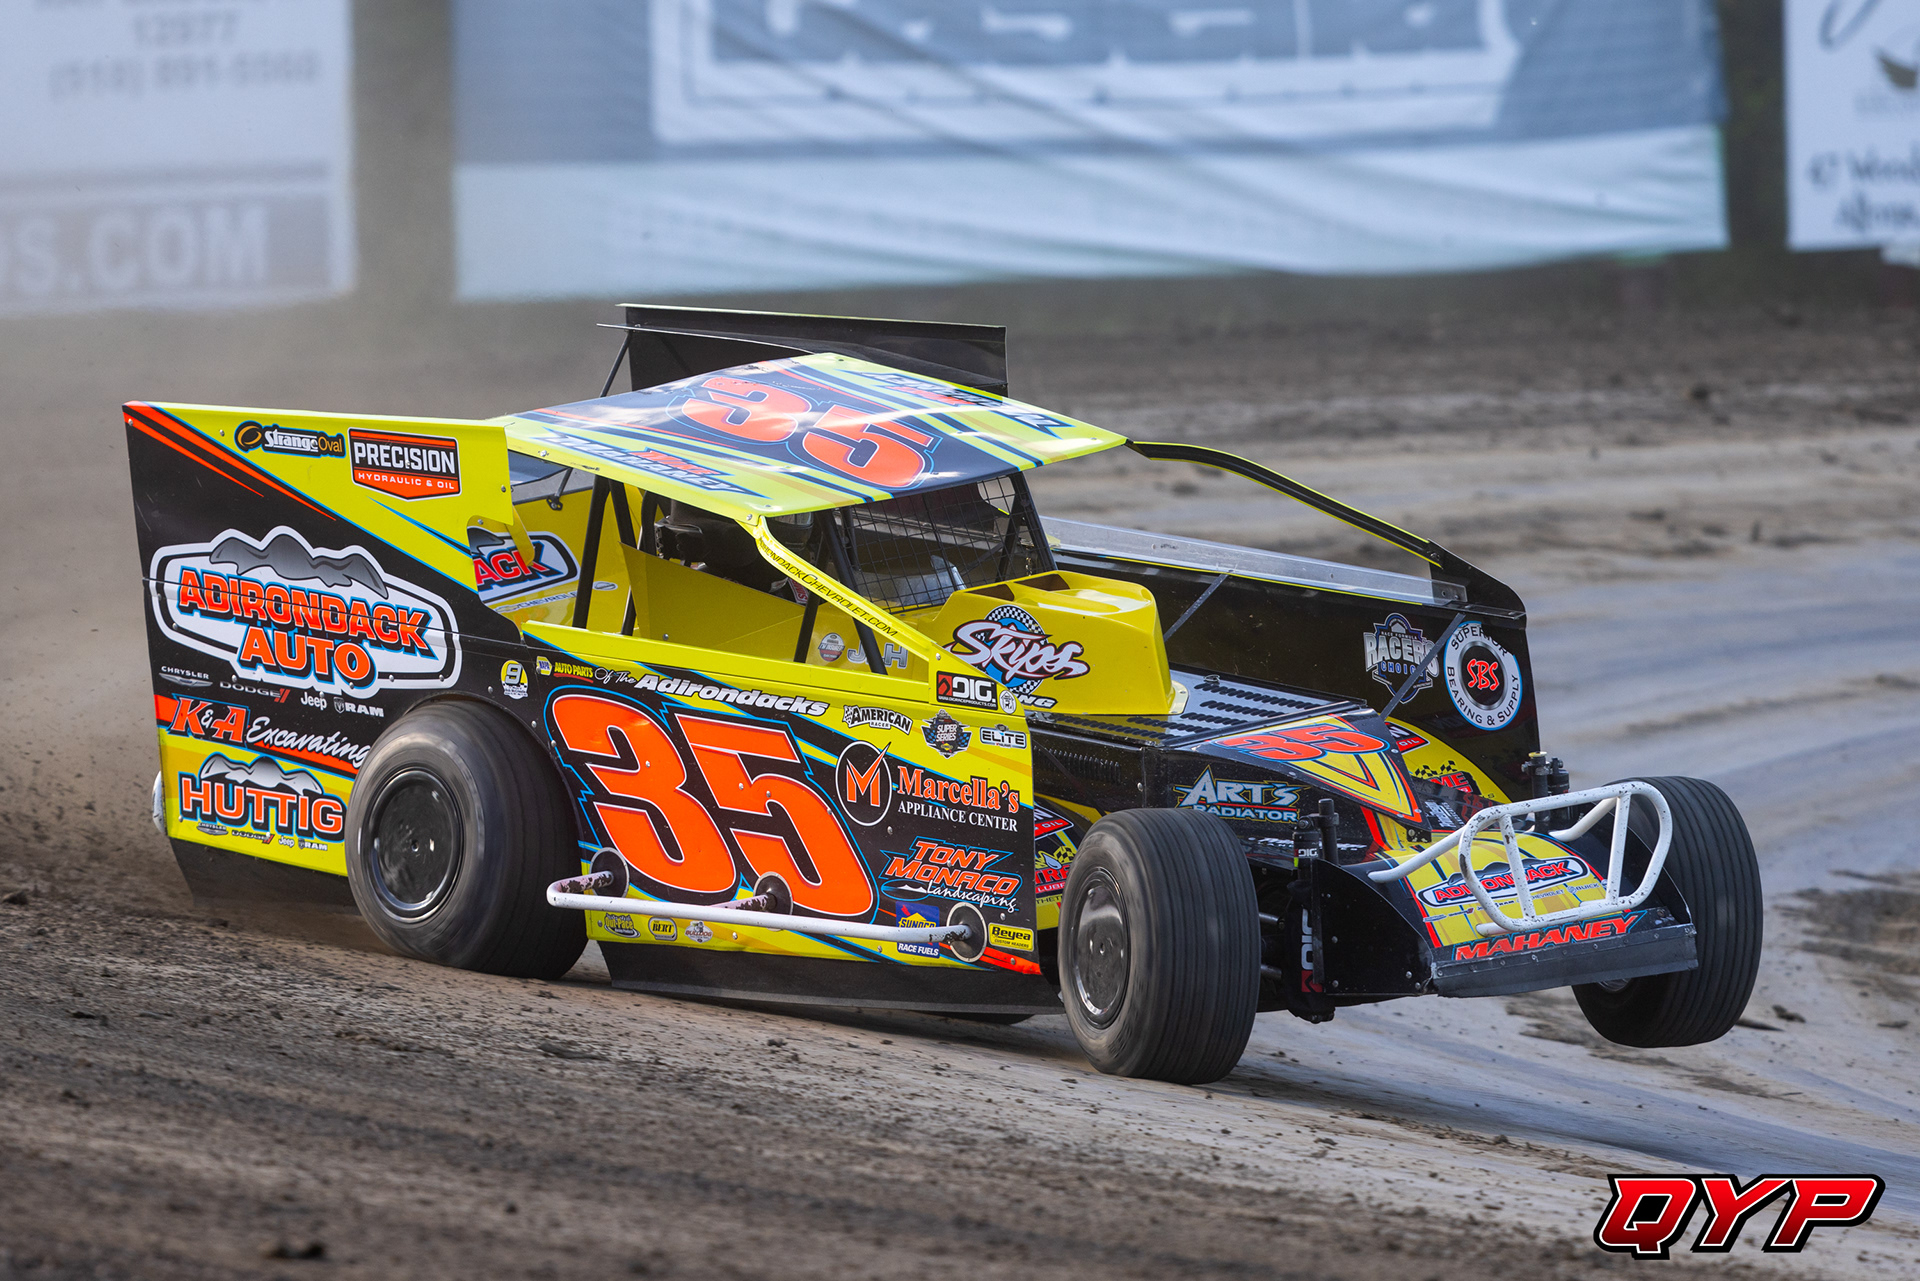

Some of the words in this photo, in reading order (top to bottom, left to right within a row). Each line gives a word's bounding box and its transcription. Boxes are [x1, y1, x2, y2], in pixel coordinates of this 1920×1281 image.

[682, 376, 934, 488] 35
[353, 442, 456, 474] PRECISION
[358, 472, 422, 486] HYDRAULIC
[437, 481, 455, 489] OIL
[179, 568, 429, 650] ADIRONDACK
[517, 591, 578, 609] CHEVROLE
[240, 625, 371, 681] AUTO
[944, 620, 1090, 683] Skips
[161, 665, 210, 679] CHRYSLER
[504, 663, 523, 686] 9
[538, 660, 550, 670] NAPA
[554, 662, 573, 675] AUTO
[573, 664, 594, 678] PARTS
[1381, 660, 1424, 677] CHOIC
[1467, 658, 1499, 691] SBS
[220, 681, 281, 698] DODGE
[595, 667, 615, 684] Of
[614, 670, 638, 684] The
[634, 674, 830, 716] Adirondacks
[1447, 666, 1483, 723] BEARING
[1487, 715, 1495, 725] &
[1497, 674, 1519, 722] SUPPLY
[300, 691, 327, 710] Jeep
[345, 703, 384, 717] RAM
[850, 706, 912, 732] AMERICAN
[937, 724, 958, 734] SUPER
[246, 716, 371, 769] Excavating
[936, 732, 957, 742] SERIES
[1214, 725, 1385, 761] 35
[1398, 738, 1420, 747] OIL
[897, 765, 1020, 813] Marcella's
[181, 776, 343, 834] HUTTIG
[552, 694, 873, 917] 35
[898, 801, 966, 824] APPLIANCE
[968, 812, 1018, 832] CENTER
[278, 836, 294, 848] Jeep
[304, 842, 328, 851] RAM
[915, 841, 999, 870] TONY
[885, 856, 1020, 895] MONACO
[1434, 861, 1573, 902] ADIONACK
[1531, 889, 1564, 899] HEVROLET
[652, 924, 673, 933] BERT
[685, 930, 712, 938] BULLDOG
[991, 926, 1031, 941] Beyea
[1456, 914, 1639, 961] MAHANEY
[898, 943, 918, 954] RACE
[918, 945, 939, 957] FUELS
[1011, 941, 1029, 949] HEADERS
